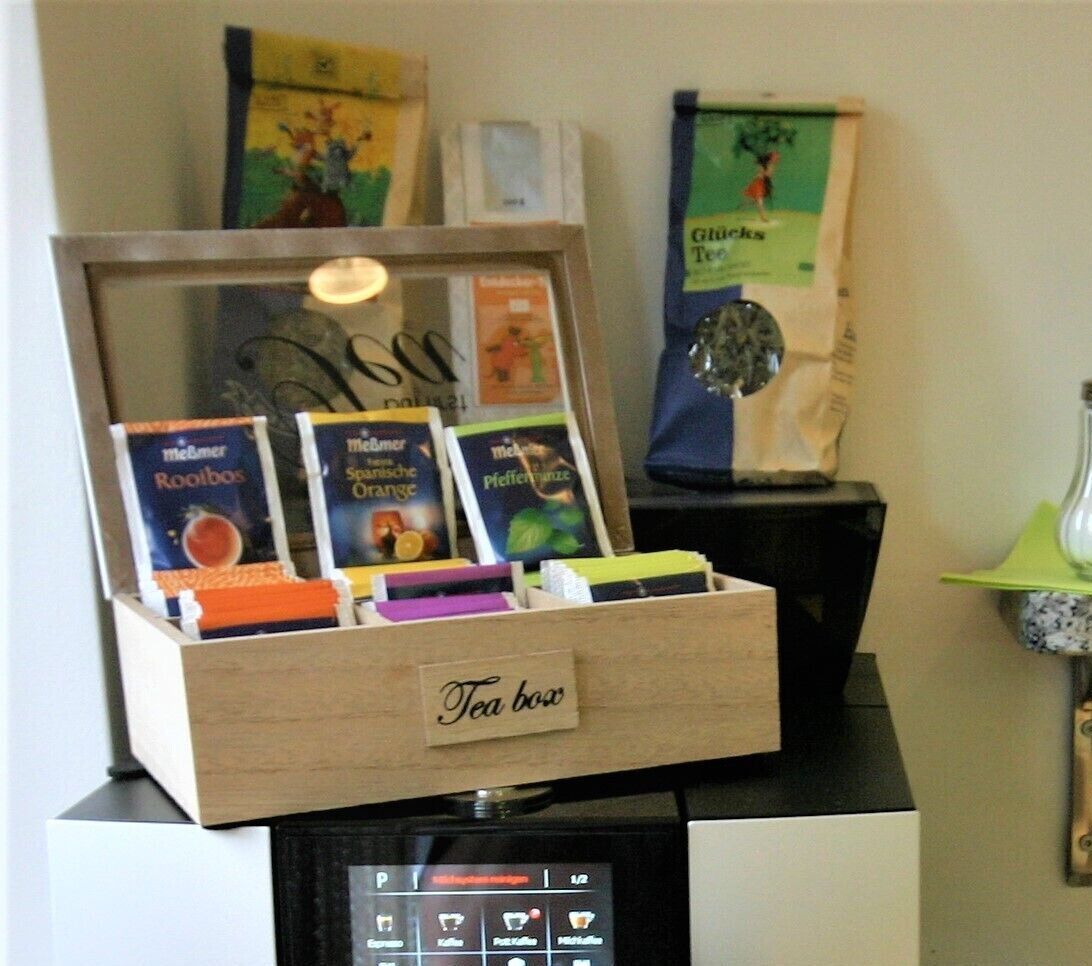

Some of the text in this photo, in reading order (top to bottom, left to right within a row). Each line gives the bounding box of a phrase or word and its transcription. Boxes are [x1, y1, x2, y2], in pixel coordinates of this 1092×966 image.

[690, 225, 766, 244] Glücks
[691, 245, 727, 264] Tee
[163, 444, 228, 462] Meßmer
[346, 437, 406, 453] Meßmer
[154, 466, 246, 490] Rooibos
[345, 464, 418, 481] Spanische
[351, 482, 418, 501] Orange
[437, 676, 565, 727] Tea box
[376, 872, 388, 889] P
[570, 874, 588, 885] 1/2
